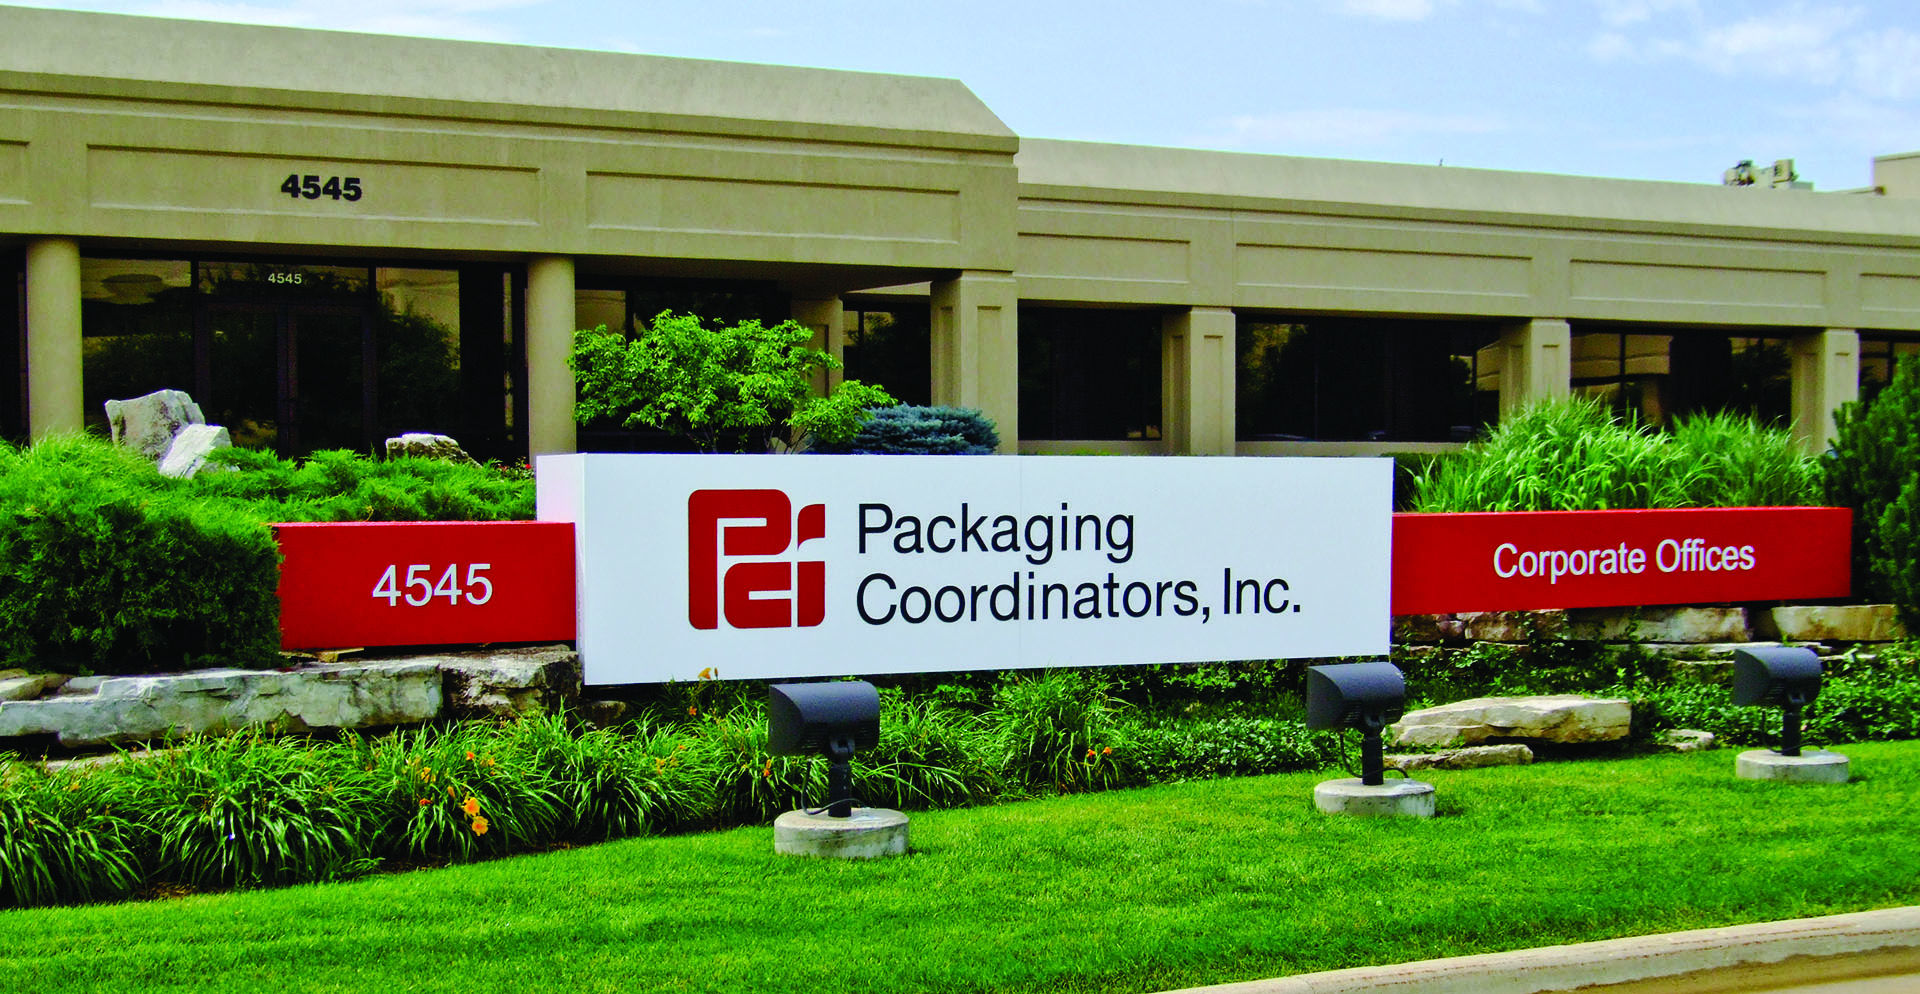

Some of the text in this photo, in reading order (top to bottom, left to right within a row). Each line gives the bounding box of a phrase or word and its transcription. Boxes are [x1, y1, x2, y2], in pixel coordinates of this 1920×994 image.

[281, 174, 363, 202] 4545
[267, 272, 303, 285] 4545
[858, 502, 1134, 565] Packaging
[1493, 538, 1755, 584] Corporate Offices
[372, 563, 493, 607] 4545
[857, 567, 1301, 625] Coordinators, Inc.
